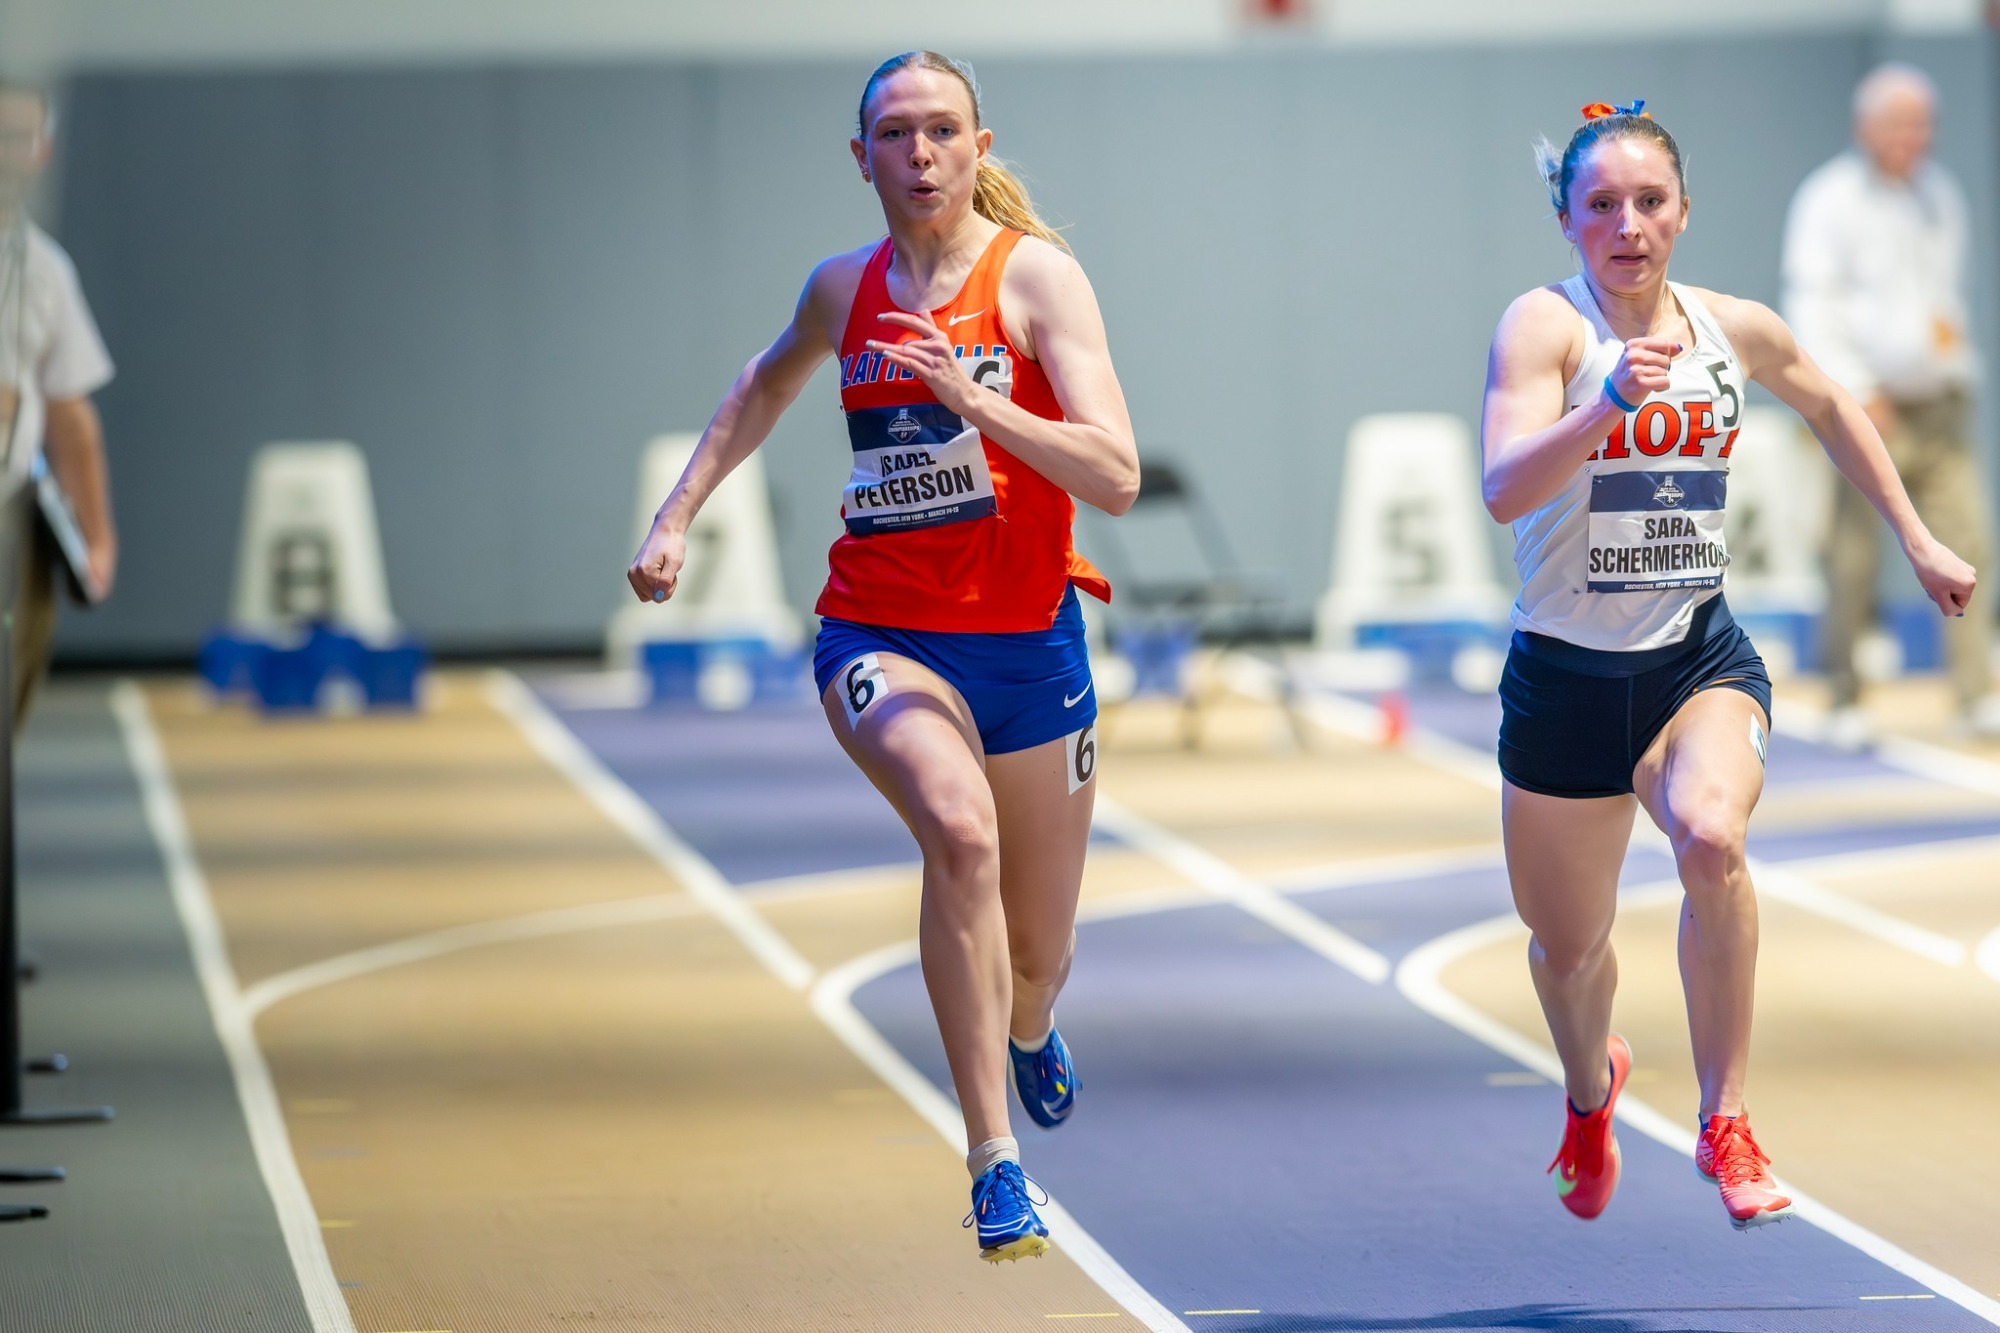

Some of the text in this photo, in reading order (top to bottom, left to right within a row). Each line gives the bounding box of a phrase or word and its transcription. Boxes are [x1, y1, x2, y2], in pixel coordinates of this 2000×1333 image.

[1706, 360, 1740, 428] 5
[854, 464, 976, 509] PETERSON
[911, 512, 925, 521] YORK
[928, 508, 946, 518] MARCH
[1643, 516, 1697, 540] SARA
[846, 661, 876, 714] 6
[1074, 724, 1095, 783] 6
